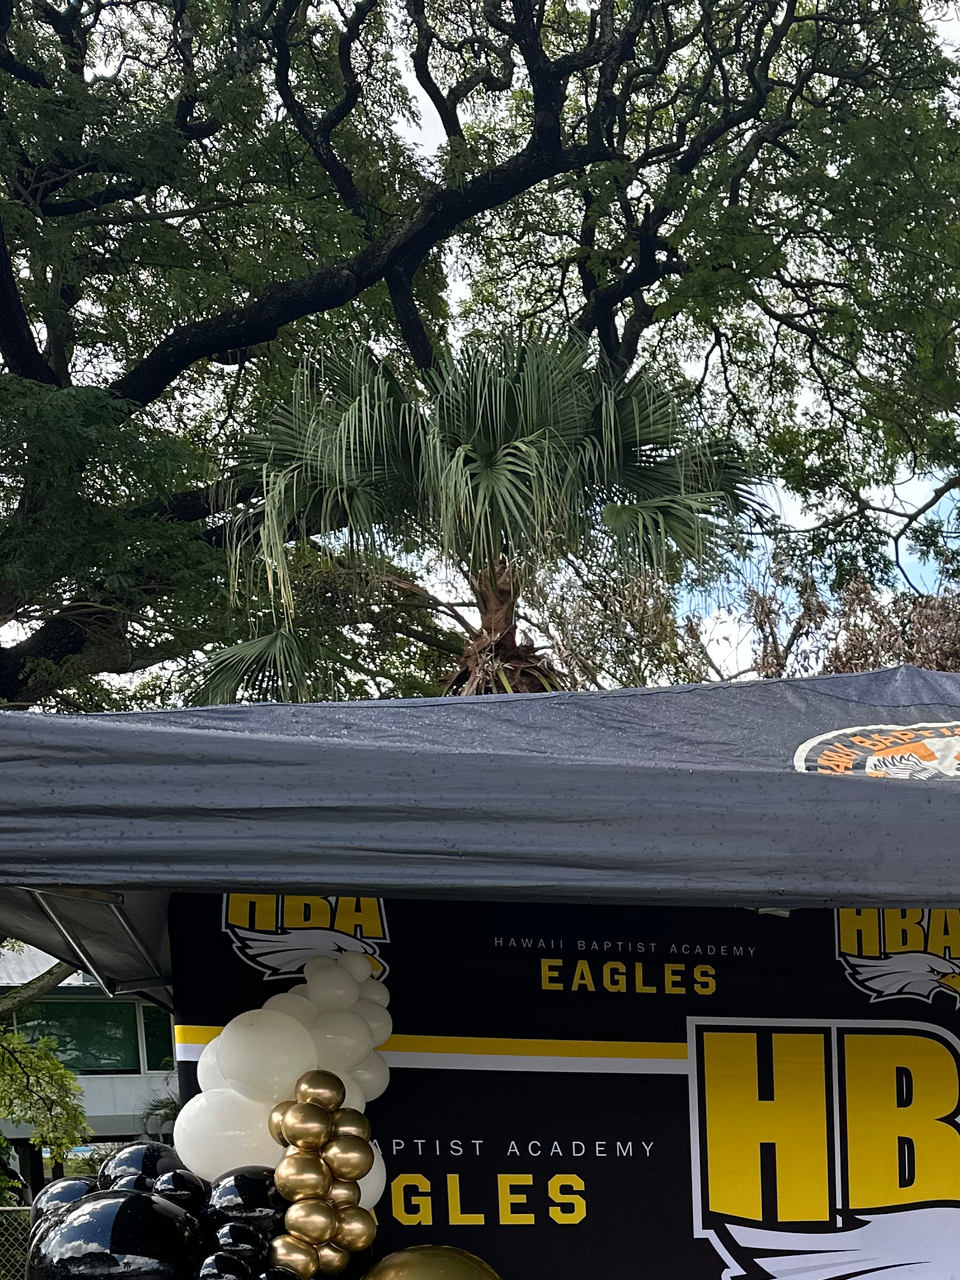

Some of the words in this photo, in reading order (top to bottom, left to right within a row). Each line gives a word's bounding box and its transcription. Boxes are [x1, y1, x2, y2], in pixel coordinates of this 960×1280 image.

[494, 936, 563, 949] HAWAII
[577, 940, 657, 953] BAPTIST
[669, 943, 756, 956] ACADEMY
[540, 958, 717, 996] EAGLES
[371, 1139, 484, 1156] APTIST
[507, 1140, 654, 1157] ACADEMY
[390, 1173, 587, 1226] GLES
